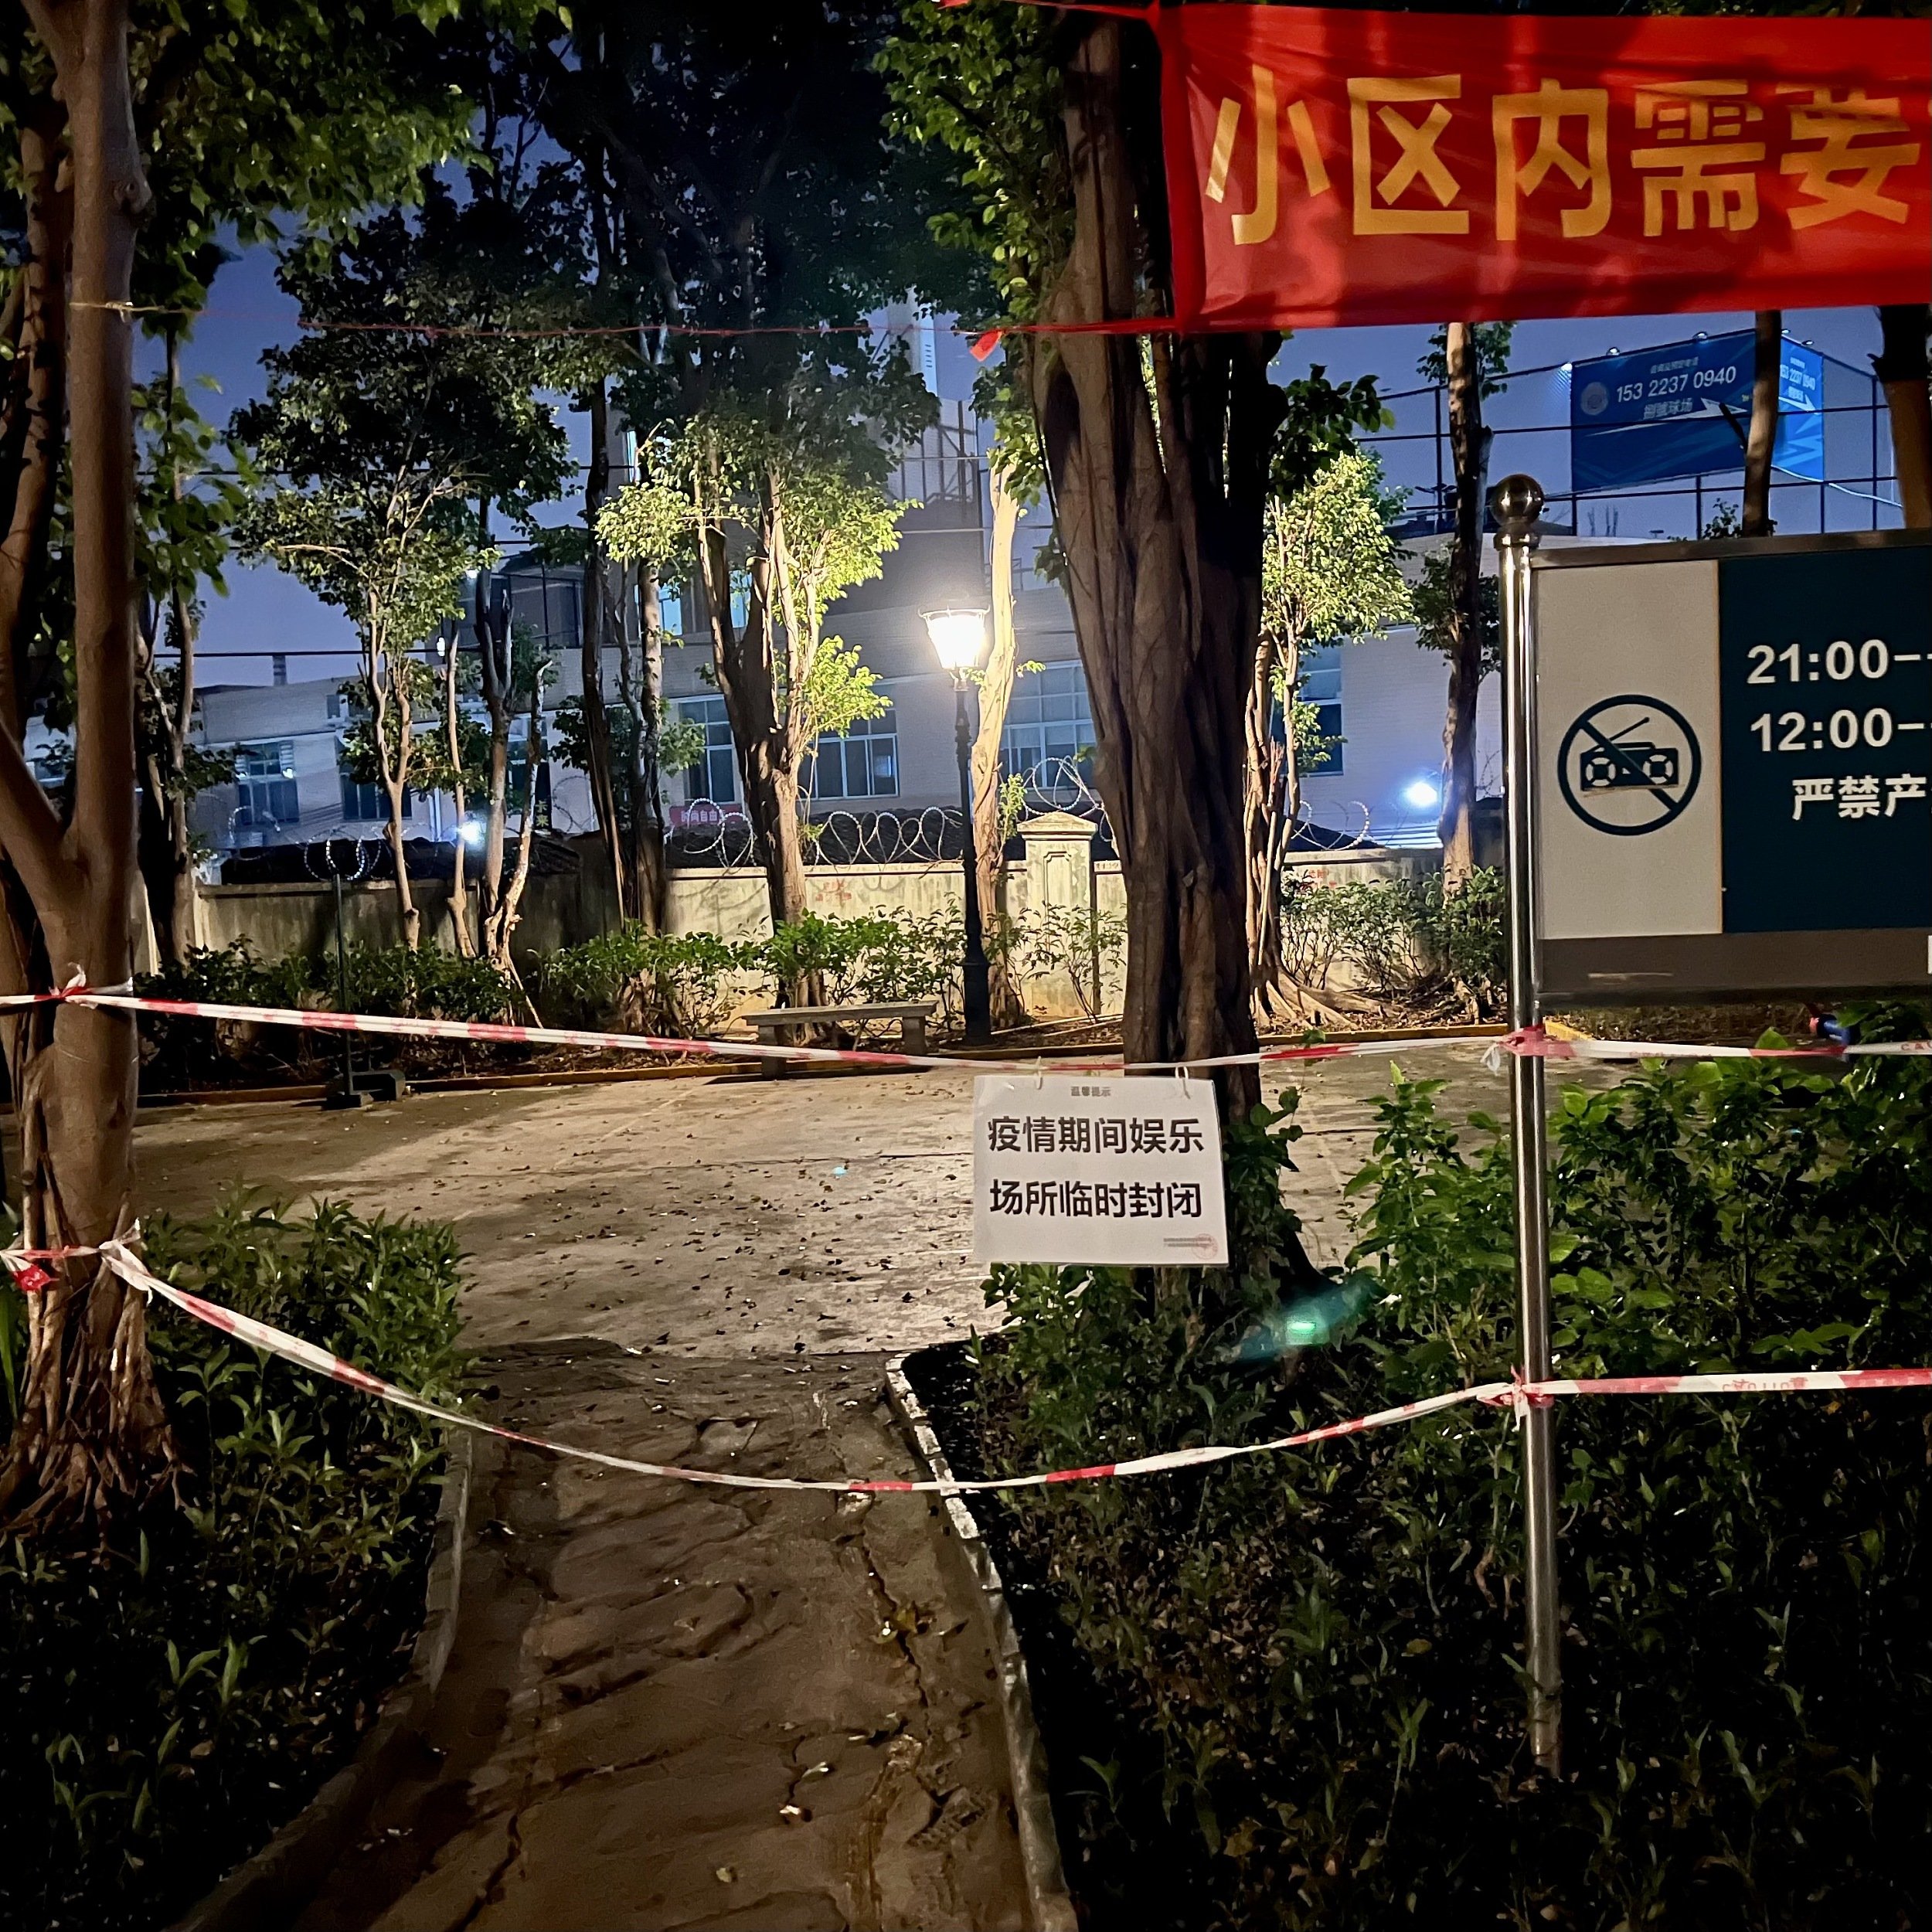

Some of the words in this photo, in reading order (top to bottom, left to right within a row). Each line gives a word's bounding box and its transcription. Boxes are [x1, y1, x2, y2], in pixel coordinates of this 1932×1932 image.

[1205, 65, 1932, 246] 小区内需要
[1617, 383, 1643, 403] 153
[1648, 374, 1689, 397] 2237
[1693, 366, 1736, 388] 0940
[1792, 773, 1932, 820] 严禁产
[988, 1116, 1205, 1154] 疫情期间娱乐
[989, 1179, 1202, 1218] 场所临时封闭
